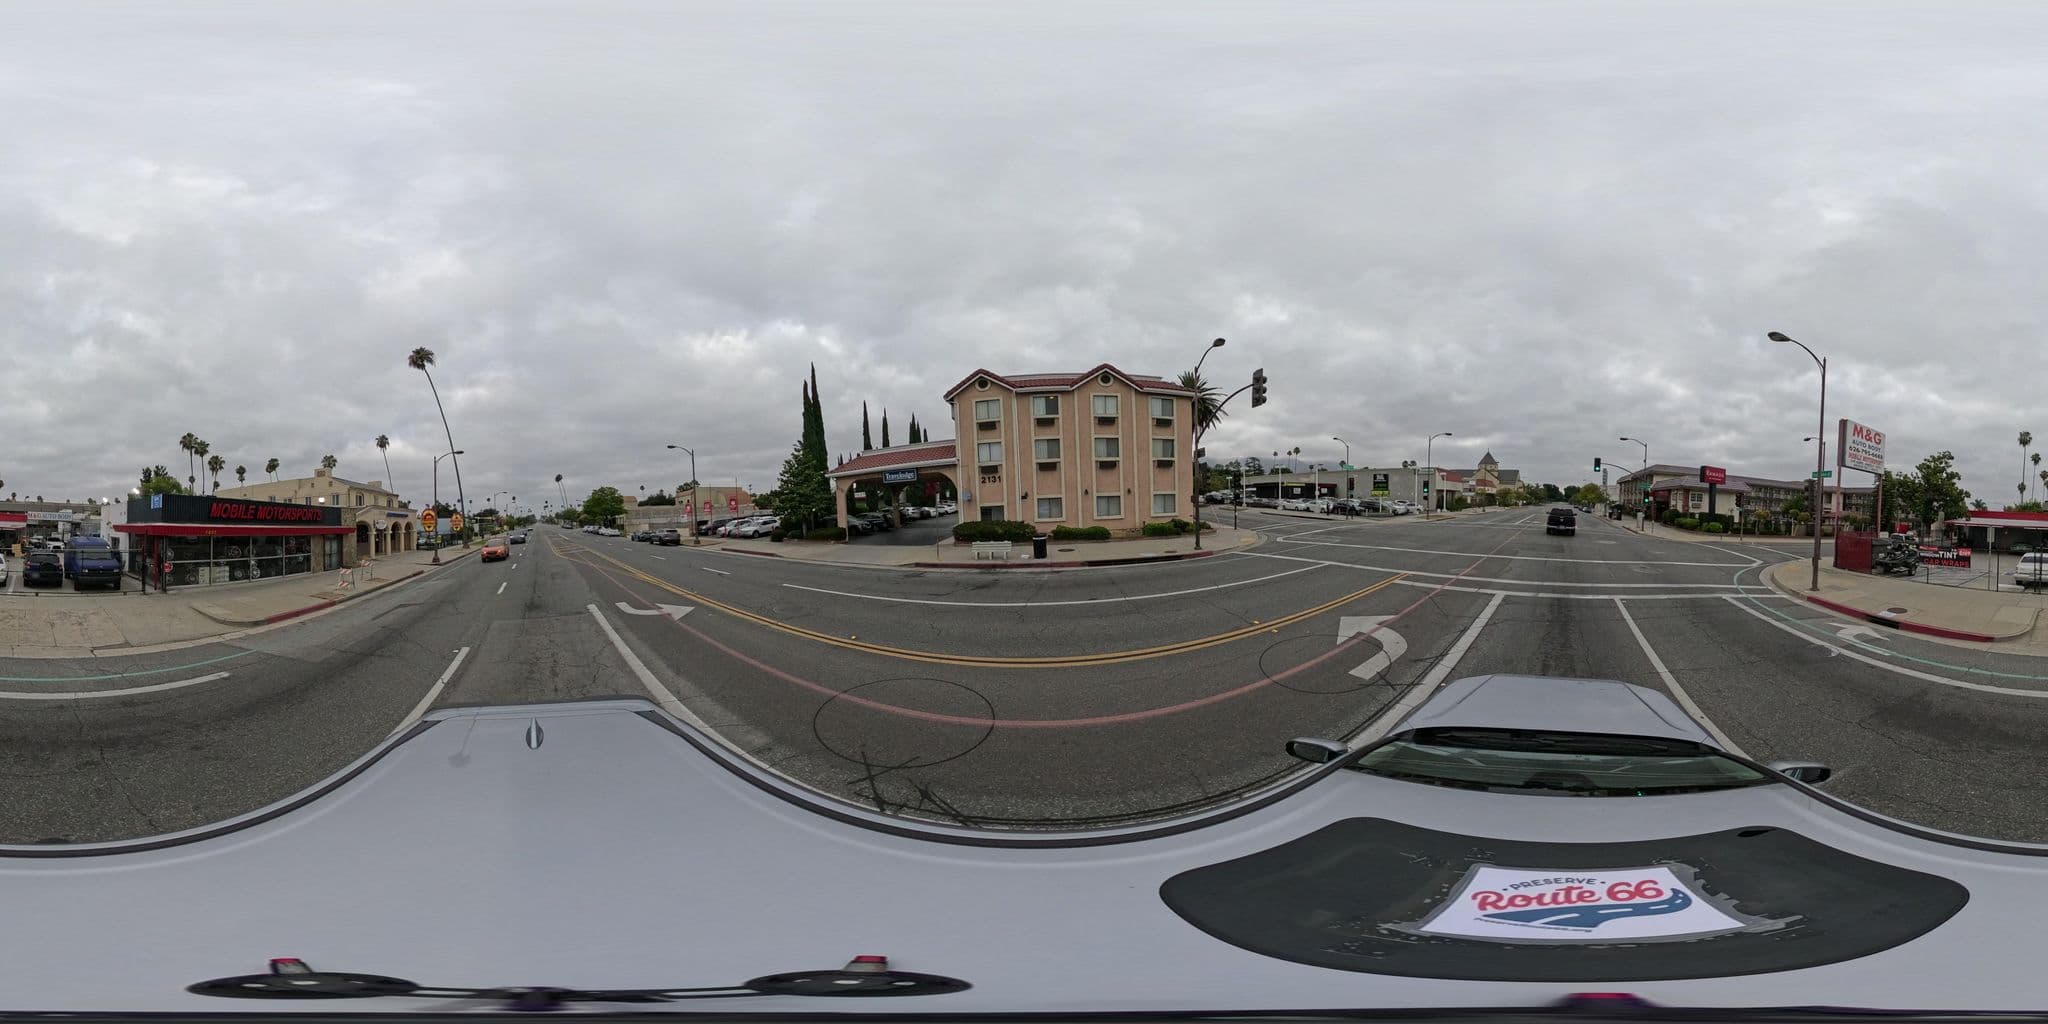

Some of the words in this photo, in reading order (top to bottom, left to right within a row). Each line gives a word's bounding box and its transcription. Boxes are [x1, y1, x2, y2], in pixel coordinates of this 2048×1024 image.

[1852, 423, 1882, 445] M&G
[980, 475, 1001, 484] 2131
[210, 502, 256, 519] MOBILE
[257, 505, 322, 520] MOTORSPORTS
[1938, 550, 1958, 559] TINT
[1509, 877, 1597, 890] PRESERVE
[1471, 886, 1602, 911] Route
[1606, 879, 1664, 901] 66
